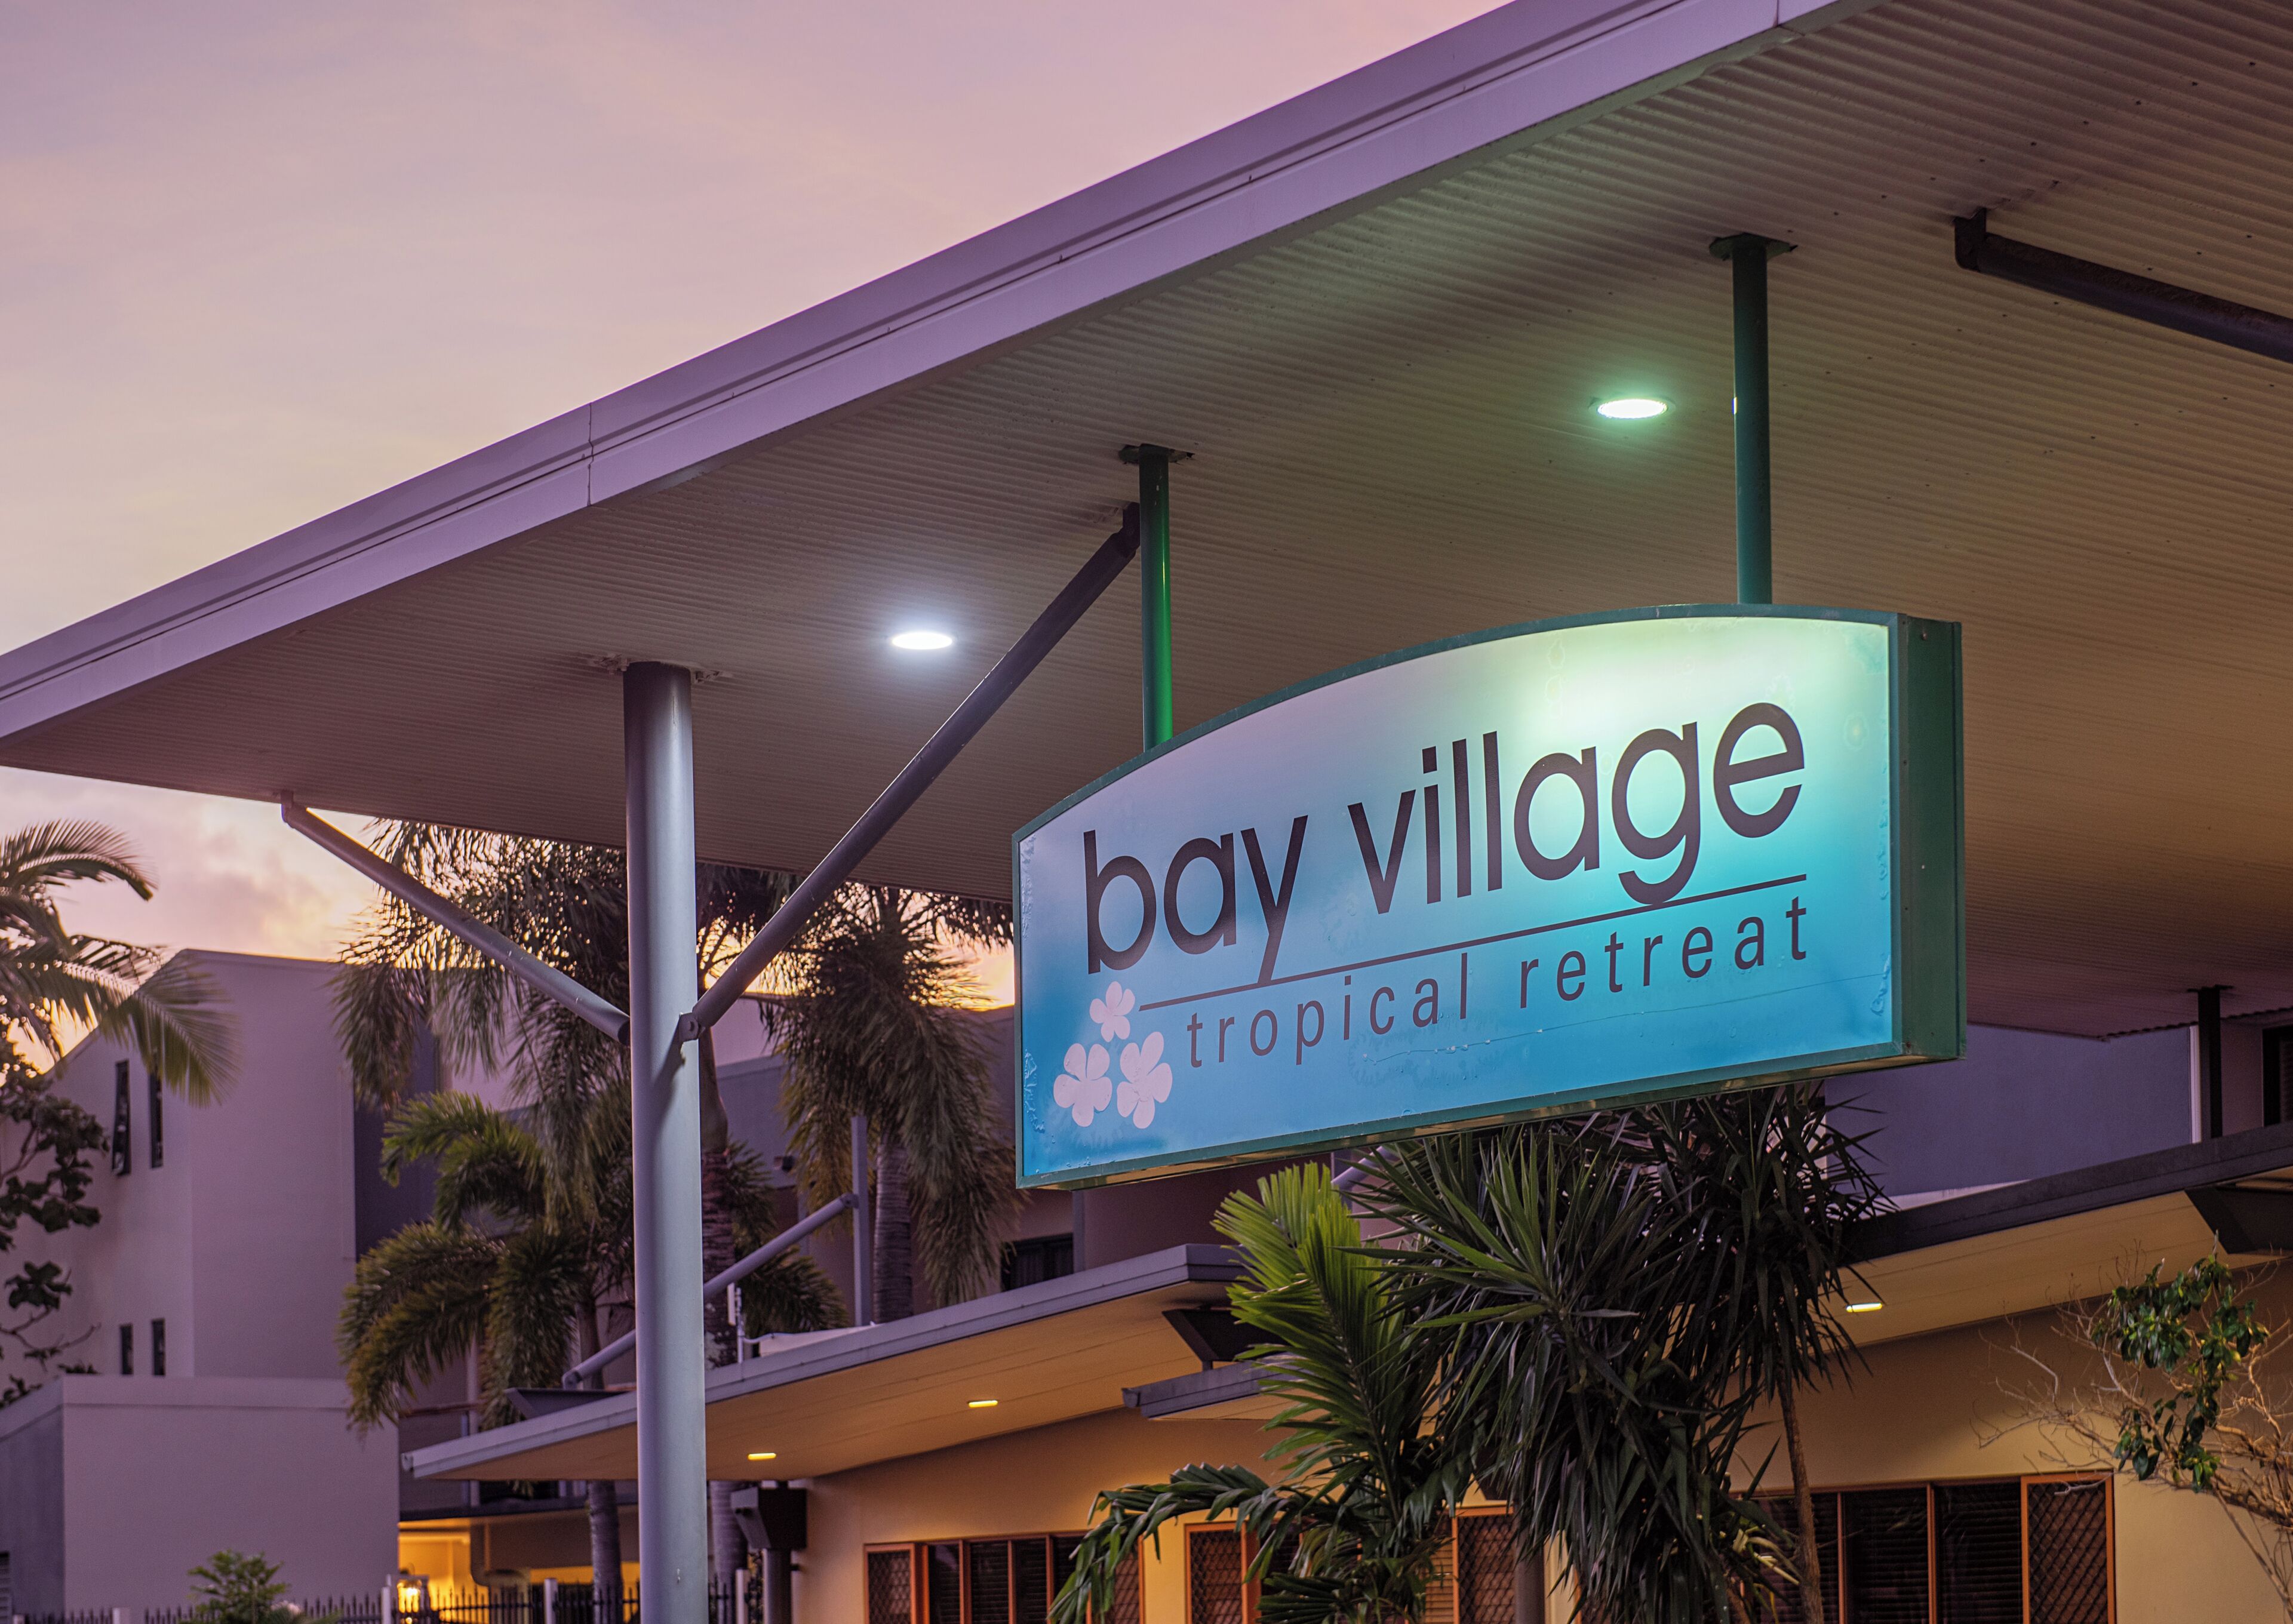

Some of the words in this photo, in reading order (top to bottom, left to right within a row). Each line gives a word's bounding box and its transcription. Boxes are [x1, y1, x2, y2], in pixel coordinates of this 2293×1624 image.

[1083, 815, 1308, 984] bay
[1347, 703, 1805, 914] village
[1187, 952, 1468, 1068] tropical
[1520, 897, 1807, 1008] retreat
